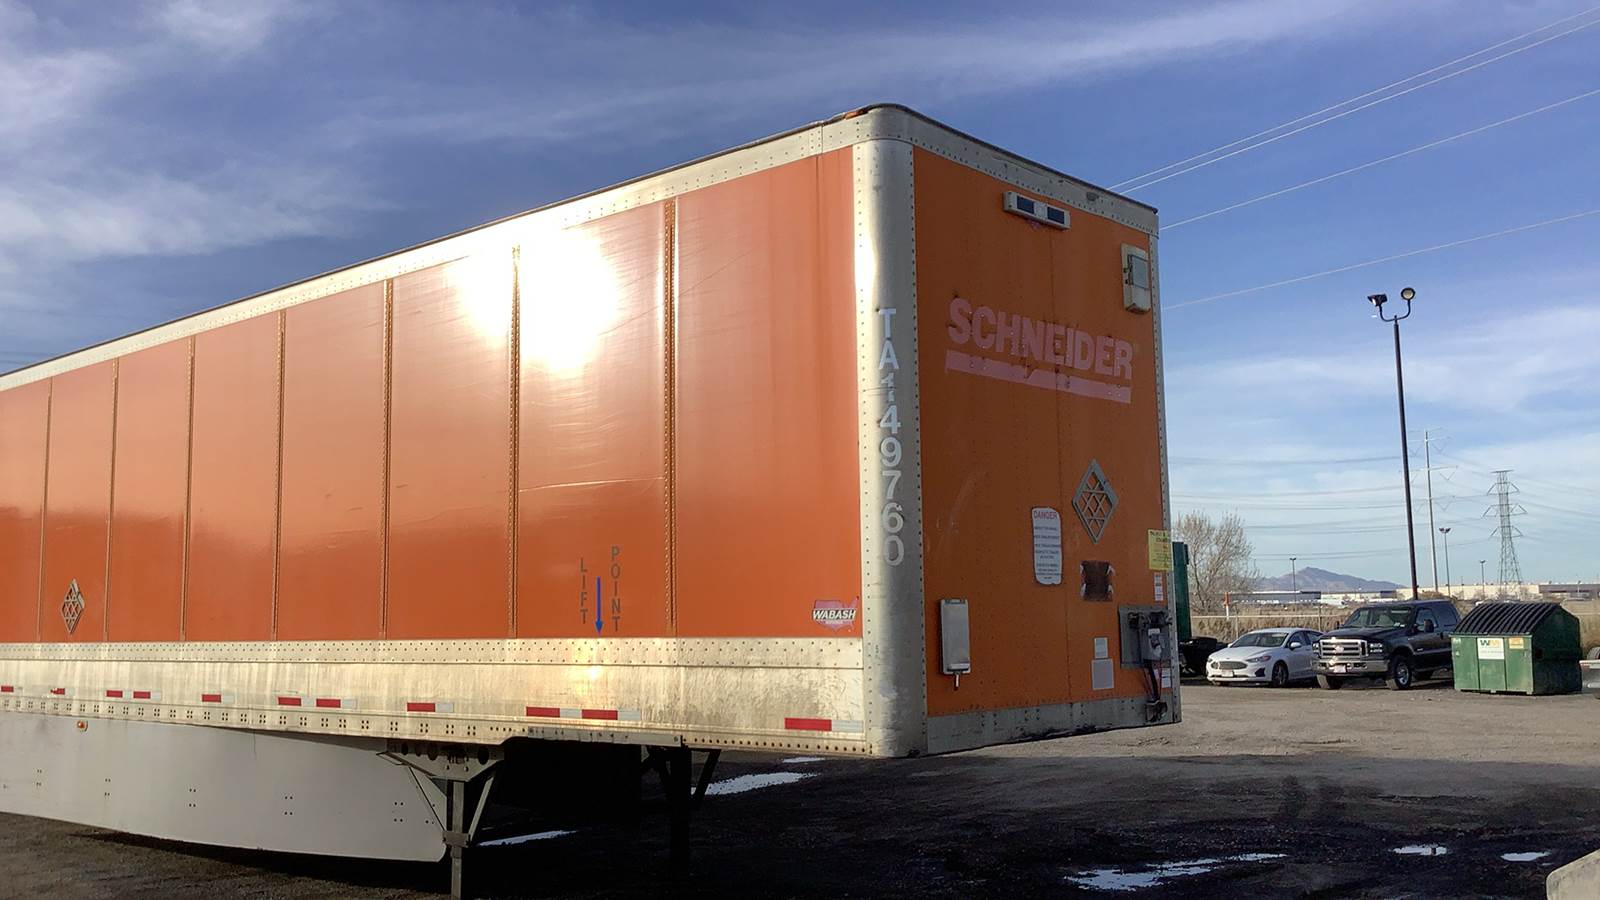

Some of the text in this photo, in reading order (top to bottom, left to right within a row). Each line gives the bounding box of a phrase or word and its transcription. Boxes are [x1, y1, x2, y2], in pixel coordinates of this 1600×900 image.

[947, 297, 1134, 380] SCHNEIDER
[1033, 510, 1058, 520] DANGER
[580, 557, 588, 624] LIFT
[610, 545, 620, 632] POINT
[813, 610, 856, 620] WABASH
